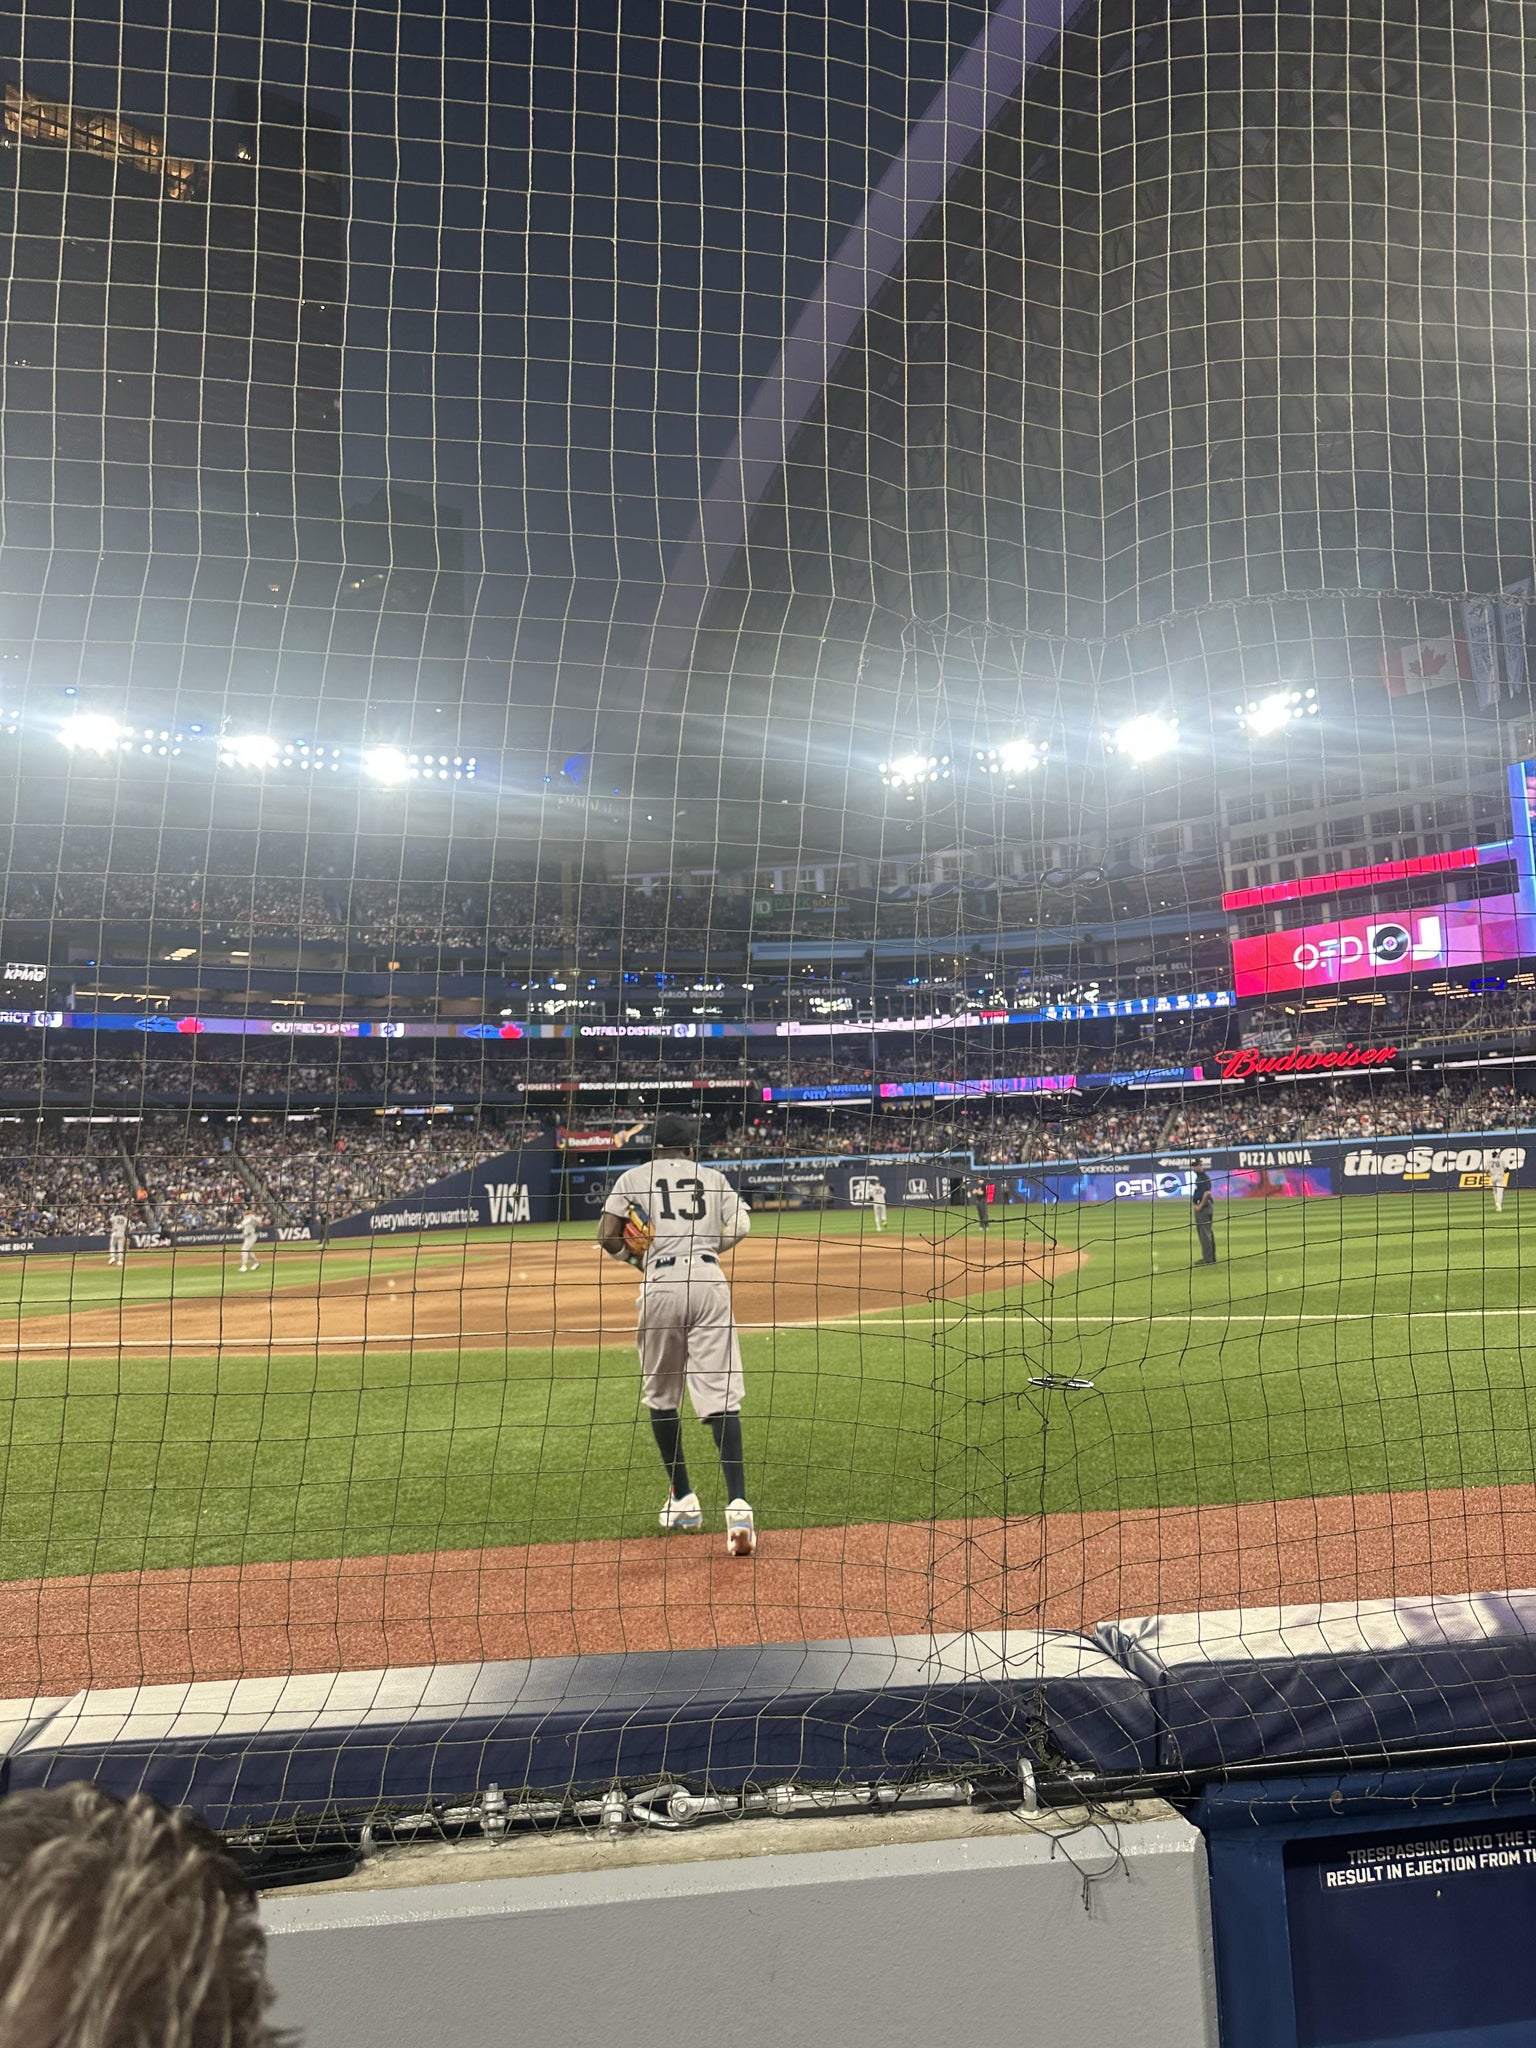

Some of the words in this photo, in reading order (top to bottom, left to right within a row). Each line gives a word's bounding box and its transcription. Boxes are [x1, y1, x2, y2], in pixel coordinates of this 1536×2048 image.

[4, 966, 46, 981] KPMG
[658, 991, 687, 999] CARLOS
[580, 1026, 626, 1036] OUTFIELD
[627, 1025, 672, 1036] DISTRICT
[1214, 1043, 1397, 1079] Budweiser
[579, 1082, 603, 1090] PROUD
[674, 1080, 693, 1088] TEAM
[1239, 1151, 1274, 1167] PIZZA
[1278, 1149, 1311, 1165] NOVA
[484, 1183, 531, 1223] VISA
[655, 1178, 706, 1220] 13
[423, 1212, 440, 1229] you
[277, 1227, 311, 1240] VISA
[12, 1242, 35, 1251] BOX
[1347, 1838, 1450, 1866] TRESPASSING
[1453, 1834, 1493, 1853] ONTO
[1495, 1831, 1524, 1848] THE
[1326, 1865, 1383, 1887] RESULT
[1386, 1863, 1402, 1880] IN
[1405, 1855, 1477, 1878] EJECTION
[1479, 1849, 1521, 1869] FROM
